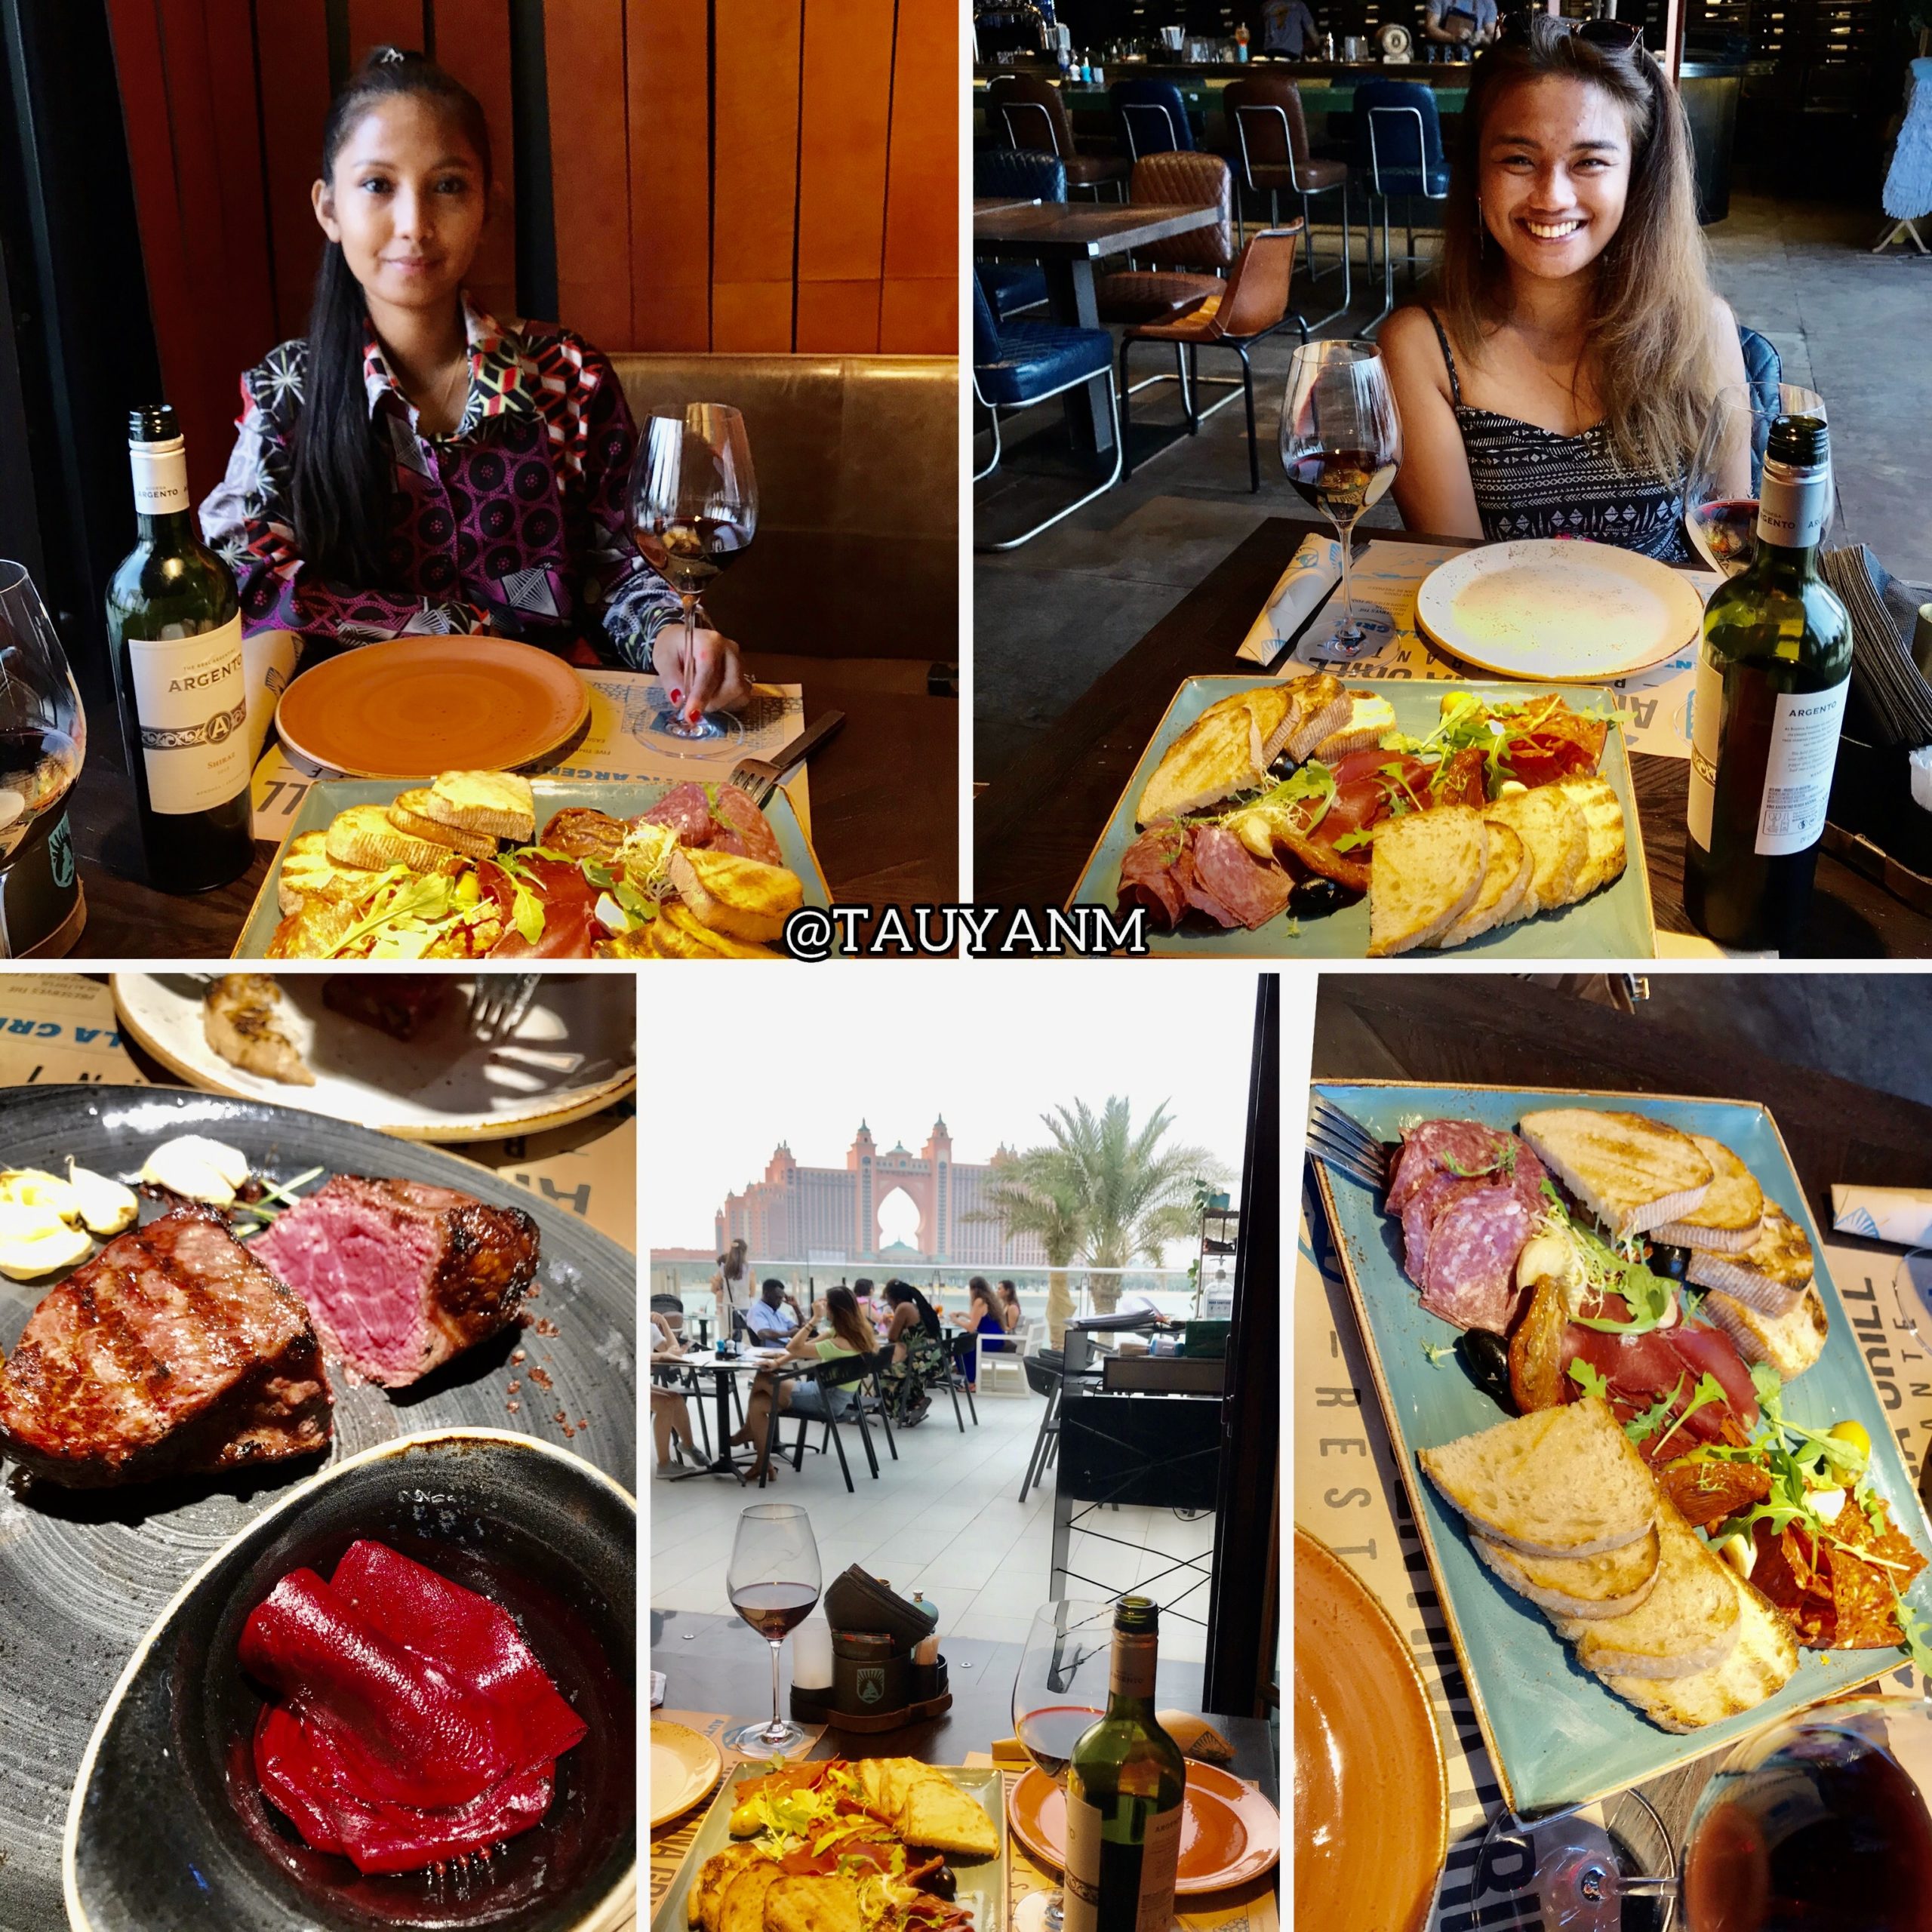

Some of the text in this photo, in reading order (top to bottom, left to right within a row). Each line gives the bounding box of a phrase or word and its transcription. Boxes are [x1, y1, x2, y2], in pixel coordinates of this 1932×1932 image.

[138, 489, 179, 498] ARGENTO
[1759, 512, 1795, 530] RGENTO
[168, 652, 242, 693] ARGENTO
[1789, 700, 1837, 717] ARGENTO
[210, 715, 229, 740] A
[208, 751, 236, 769] SHIRAZ
[75, 1026, 122, 1048] LA
